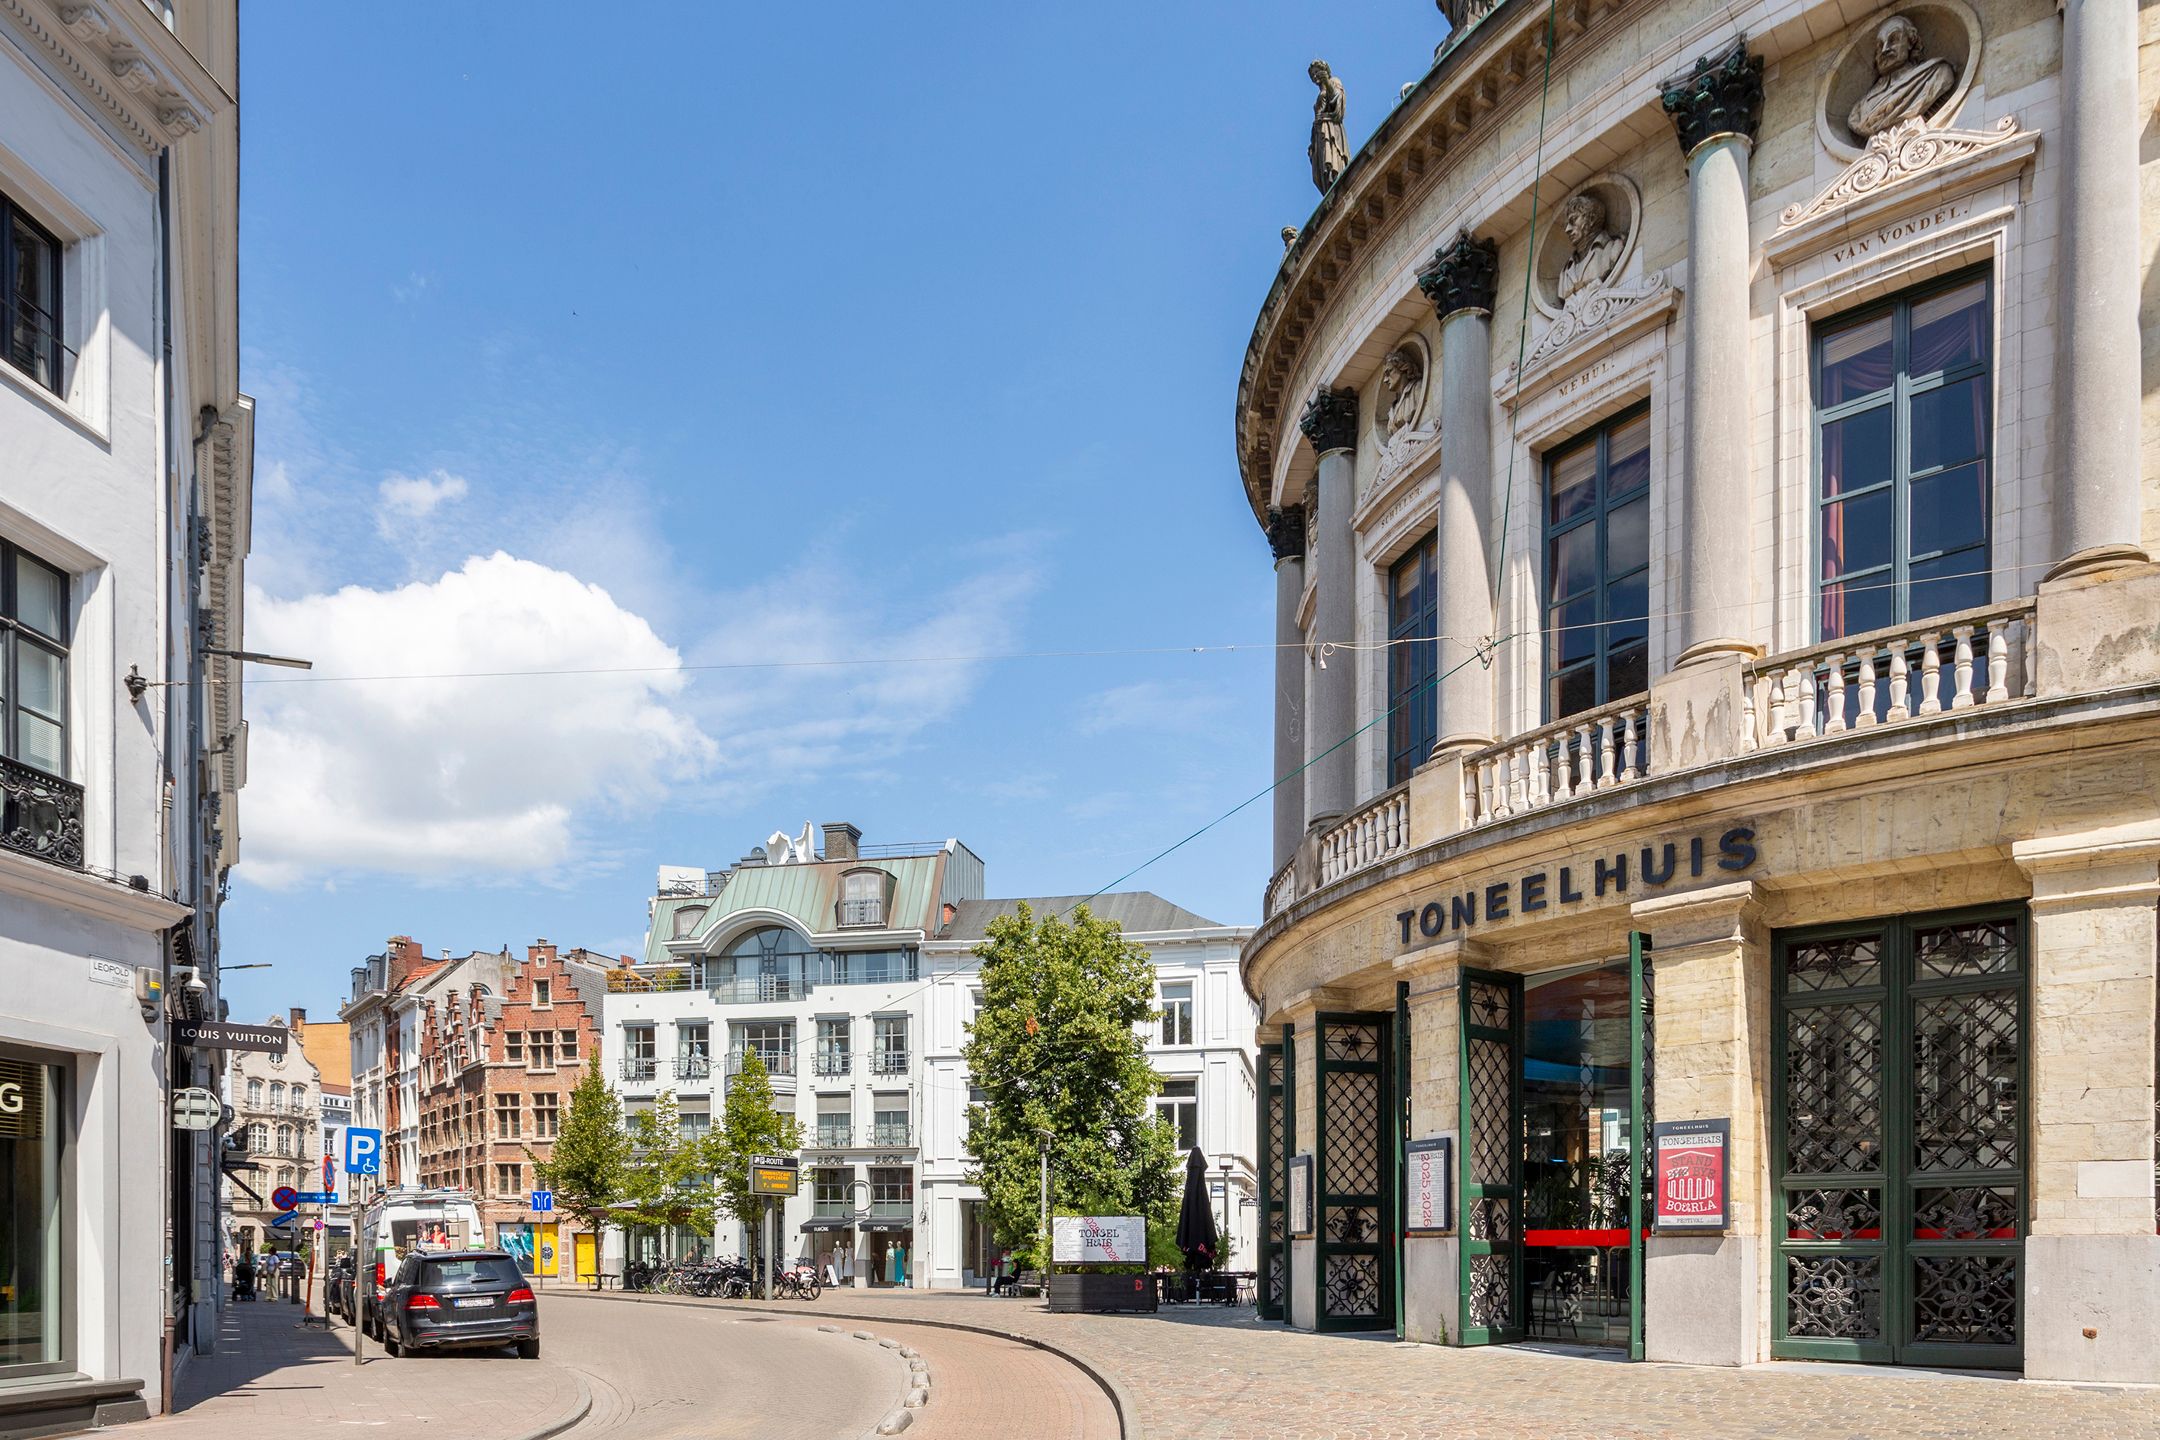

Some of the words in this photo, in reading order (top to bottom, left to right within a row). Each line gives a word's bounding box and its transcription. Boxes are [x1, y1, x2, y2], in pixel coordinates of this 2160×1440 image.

[1833, 239, 1871, 263] VAN
[1396, 827, 1756, 944] TONEELHUIS
[93, 961, 130, 977] LEOPOLD
[181, 1027, 220, 1040] LOUIS
[226, 1031, 283, 1045] VUITTON
[0, 1082, 24, 1113] G
[350, 1135, 376, 1166] P
